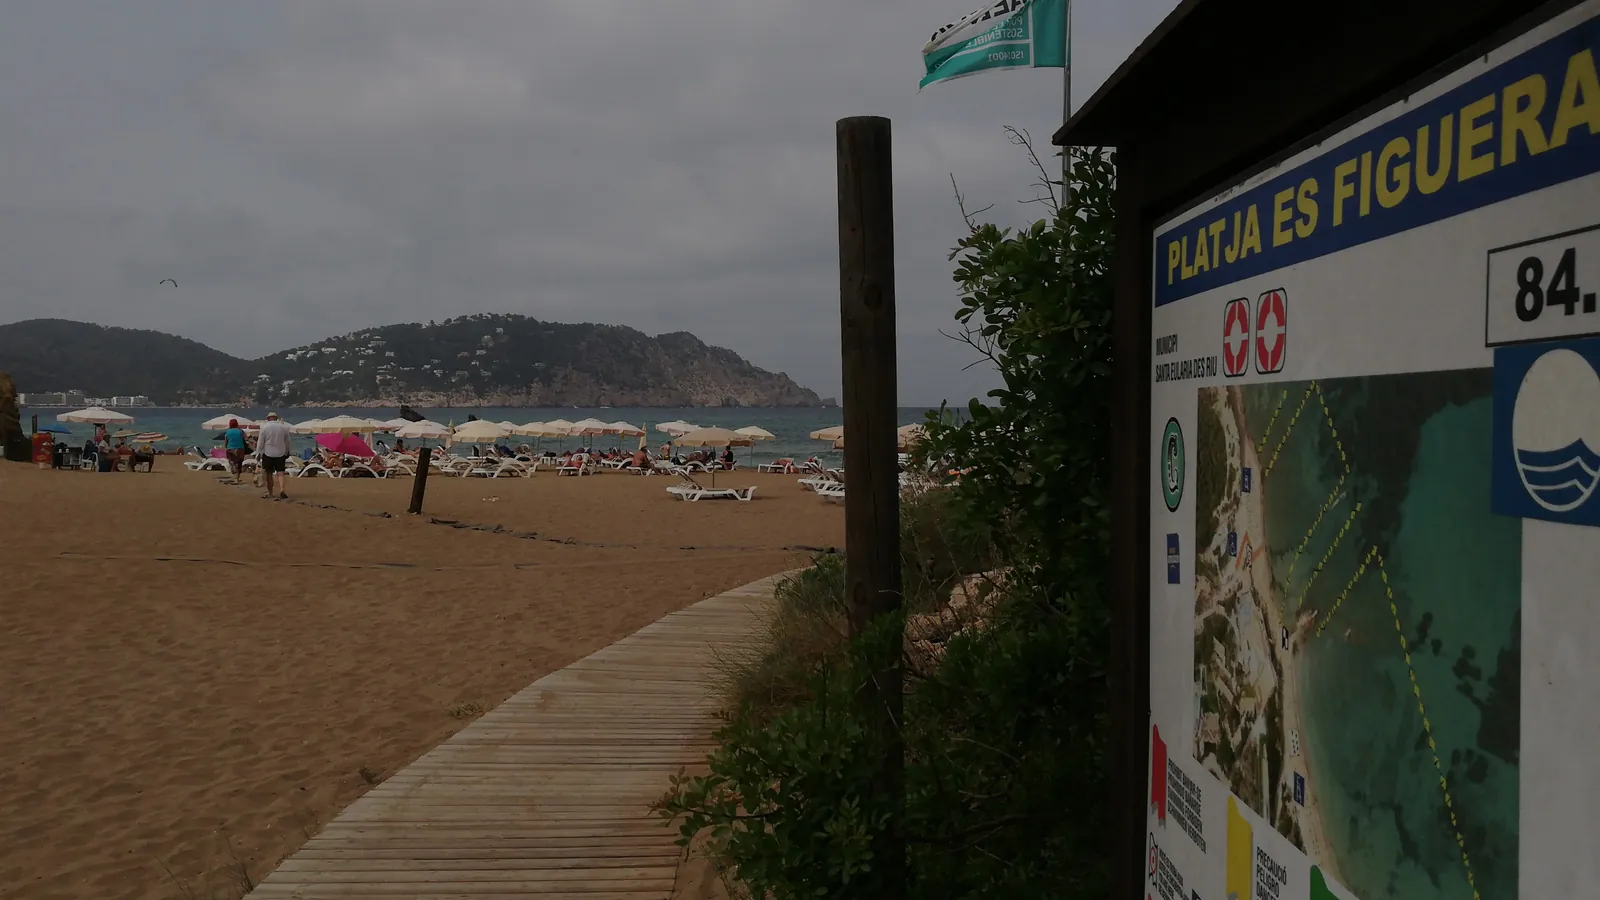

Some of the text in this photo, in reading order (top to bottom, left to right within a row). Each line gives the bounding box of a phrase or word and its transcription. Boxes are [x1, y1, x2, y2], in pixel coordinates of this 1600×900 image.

[1168, 48, 1600, 285] PLATJA ES FIGUERA
[1156, 334, 1178, 356] MUNICIPI
[1156, 363, 1170, 382] SANTA
[1193, 357, 1205, 378] DES
[1206, 355, 1218, 377] RIU
[1257, 846, 1286, 885] PRECAUCIÓ
[1257, 864, 1279, 897] PELIGRO
